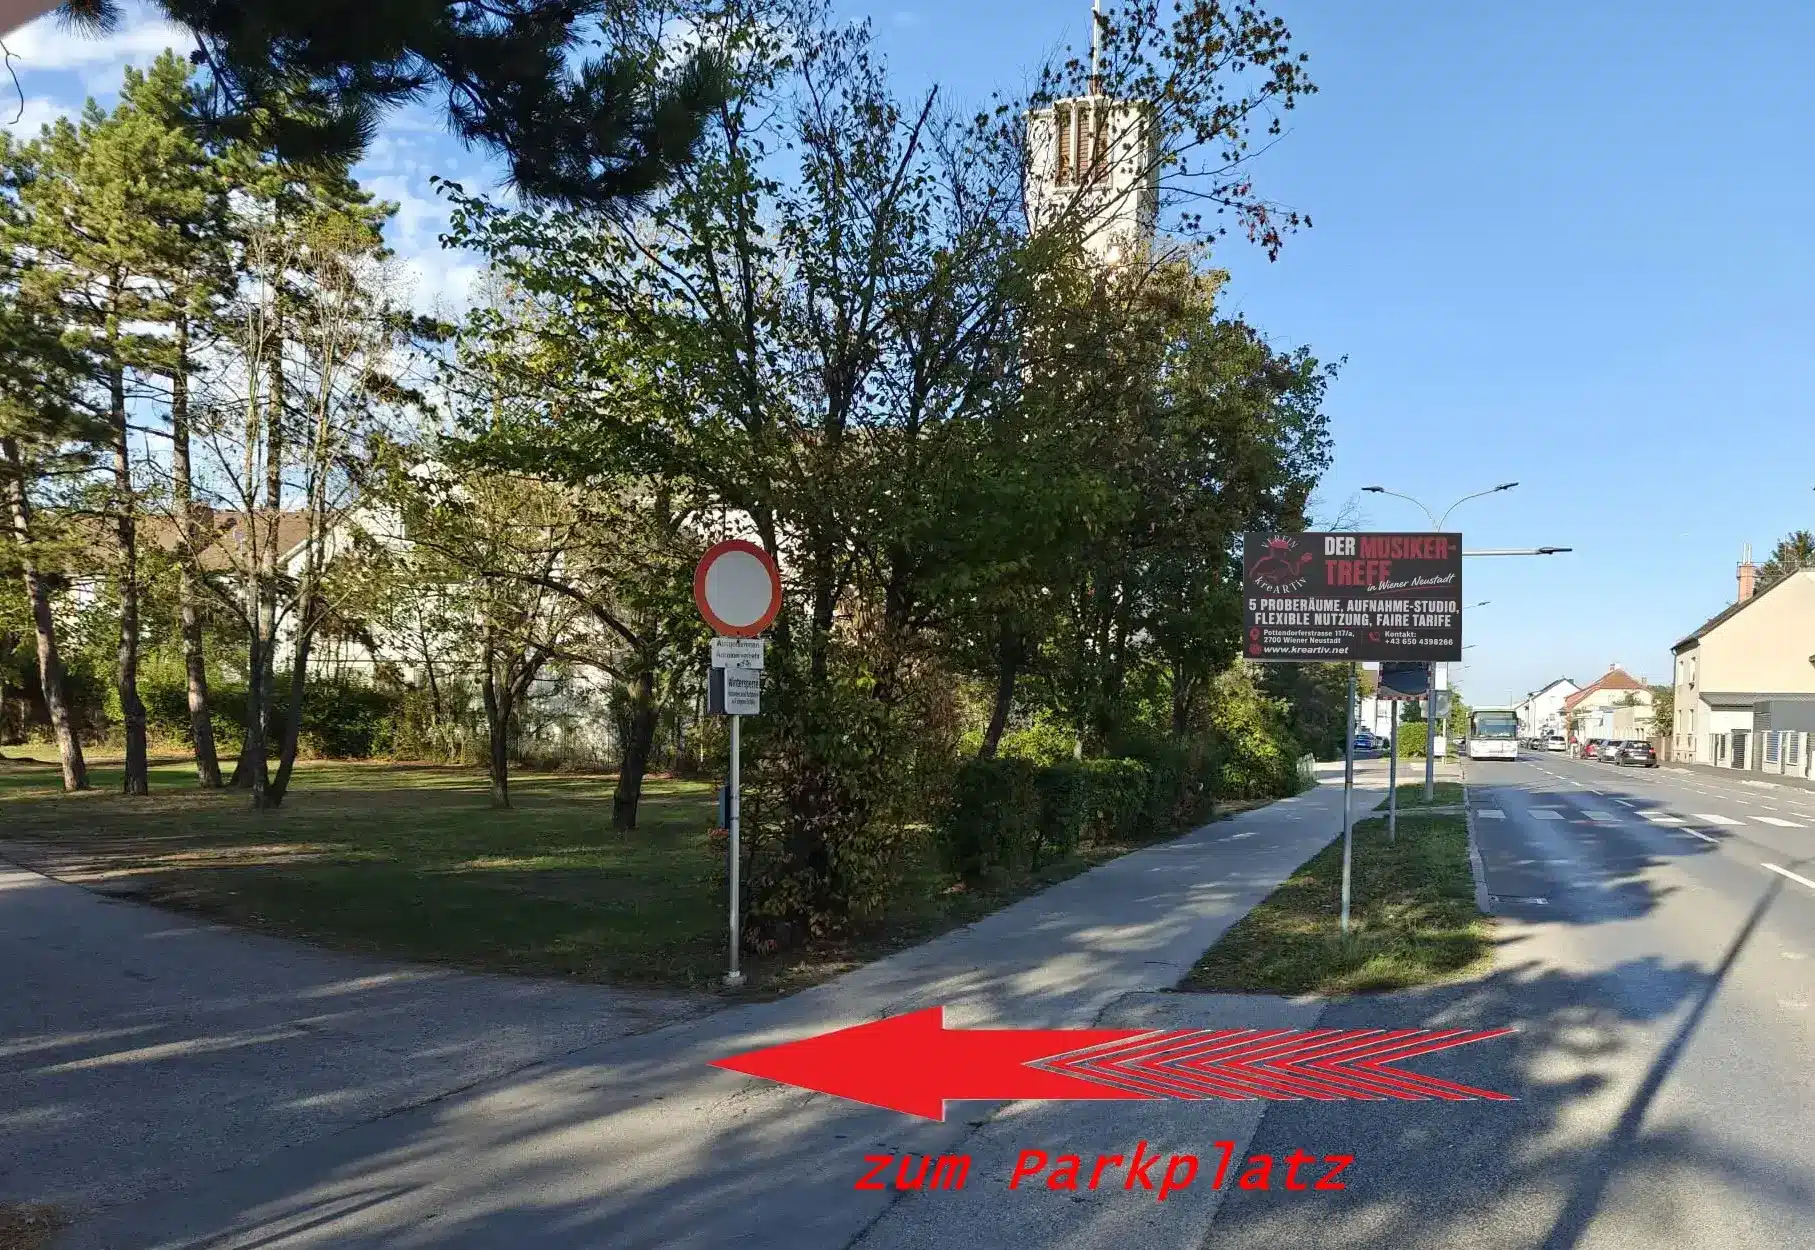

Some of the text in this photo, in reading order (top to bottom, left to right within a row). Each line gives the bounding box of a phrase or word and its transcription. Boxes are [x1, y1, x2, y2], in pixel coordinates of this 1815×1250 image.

[1261, 535, 1298, 550] VEREIN
[1324, 536, 1456, 560] DER MUSIKER-
[1325, 559, 1392, 585] TREFF
[1367, 573, 1456, 592] in Wiener Neustadt
[1248, 597, 1460, 614] 5 PROBERÄUME, AUFNAHME-STUDIO,
[1254, 613, 1451, 627] FLEXIBLE NUTZUNG, FAIRE TARIFE
[1263, 629, 1355, 638] Pottendorferstrasse 117/a,
[1283, 636, 1308, 644] Wiener
[1309, 636, 1341, 644] Neustadt
[1263, 645, 1349, 654] www.kreartiv.net
